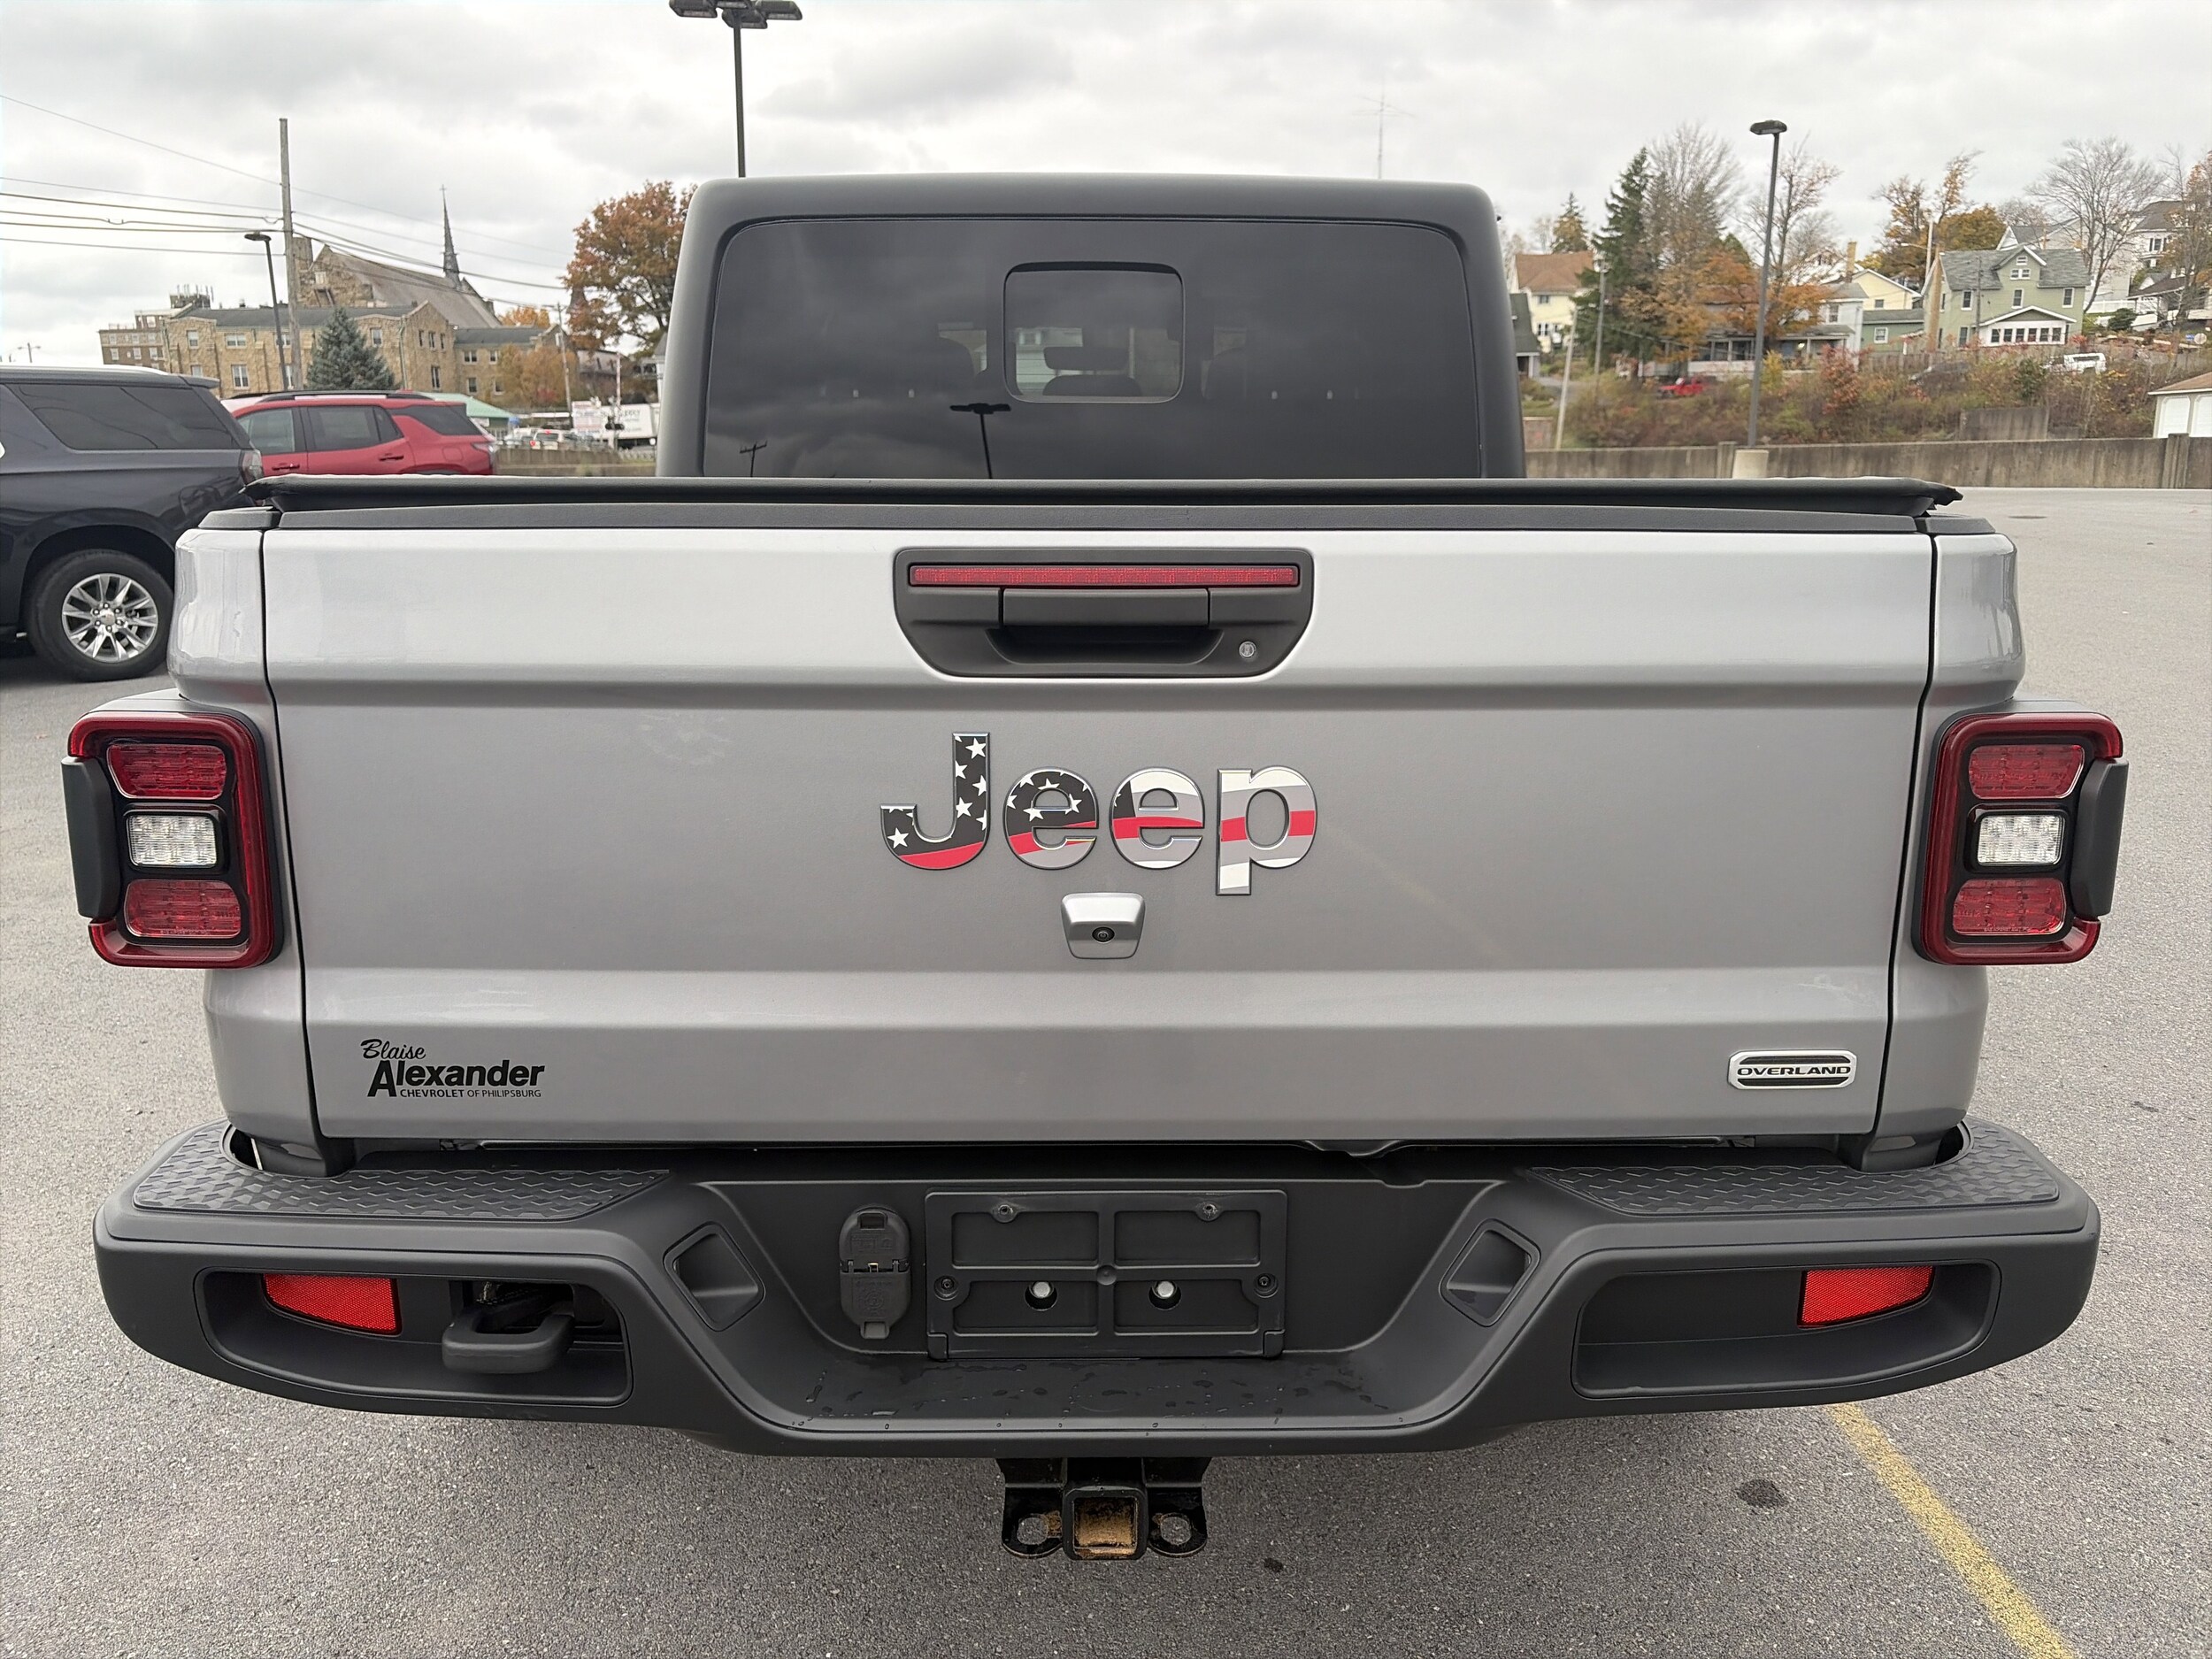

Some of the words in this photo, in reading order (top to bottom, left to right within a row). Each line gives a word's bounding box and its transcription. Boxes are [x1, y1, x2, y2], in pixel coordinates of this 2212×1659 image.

[879, 732, 1317, 895] Jeep
[360, 1039, 426, 1059] Blaise
[367, 1060, 545, 1097] Alexander
[1737, 1066, 1851, 1076] OVERLAND
[400, 1089, 465, 1098] CHEVROLET
[467, 1089, 480, 1098] OF
[482, 1089, 541, 1098] PHILIPSBURG
